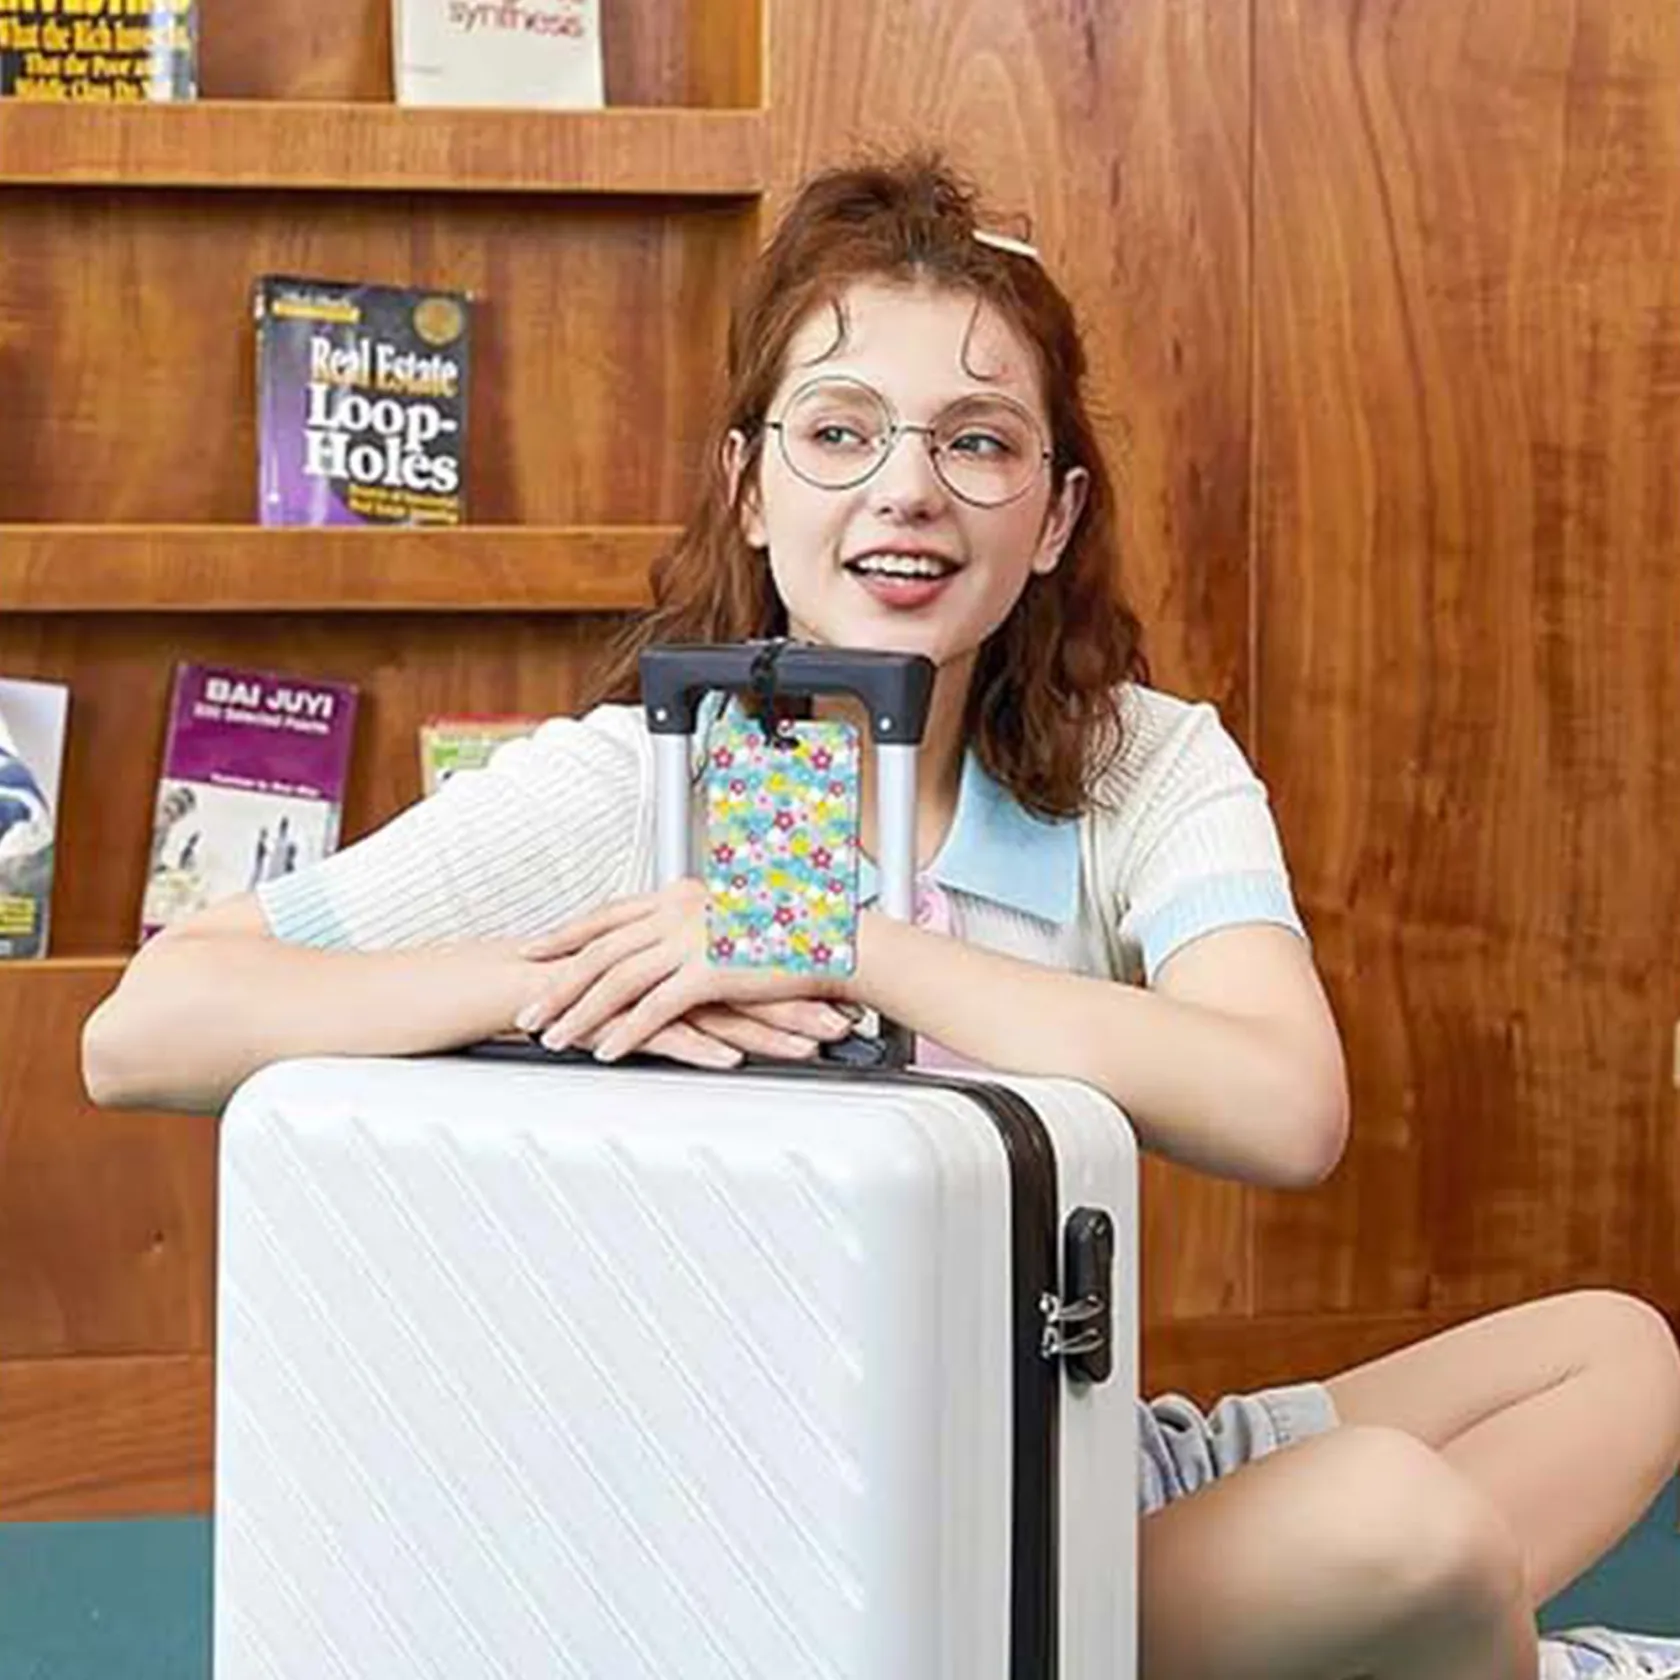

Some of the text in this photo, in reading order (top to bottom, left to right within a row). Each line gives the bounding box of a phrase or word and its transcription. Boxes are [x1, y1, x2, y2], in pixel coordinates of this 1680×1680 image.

[447, 1, 584, 38] synthesis
[310, 336, 458, 398] Real Estate
[306, 382, 458, 452] Loop-
[303, 429, 459, 492] Holes
[206, 678, 333, 718] BAI JUYI
